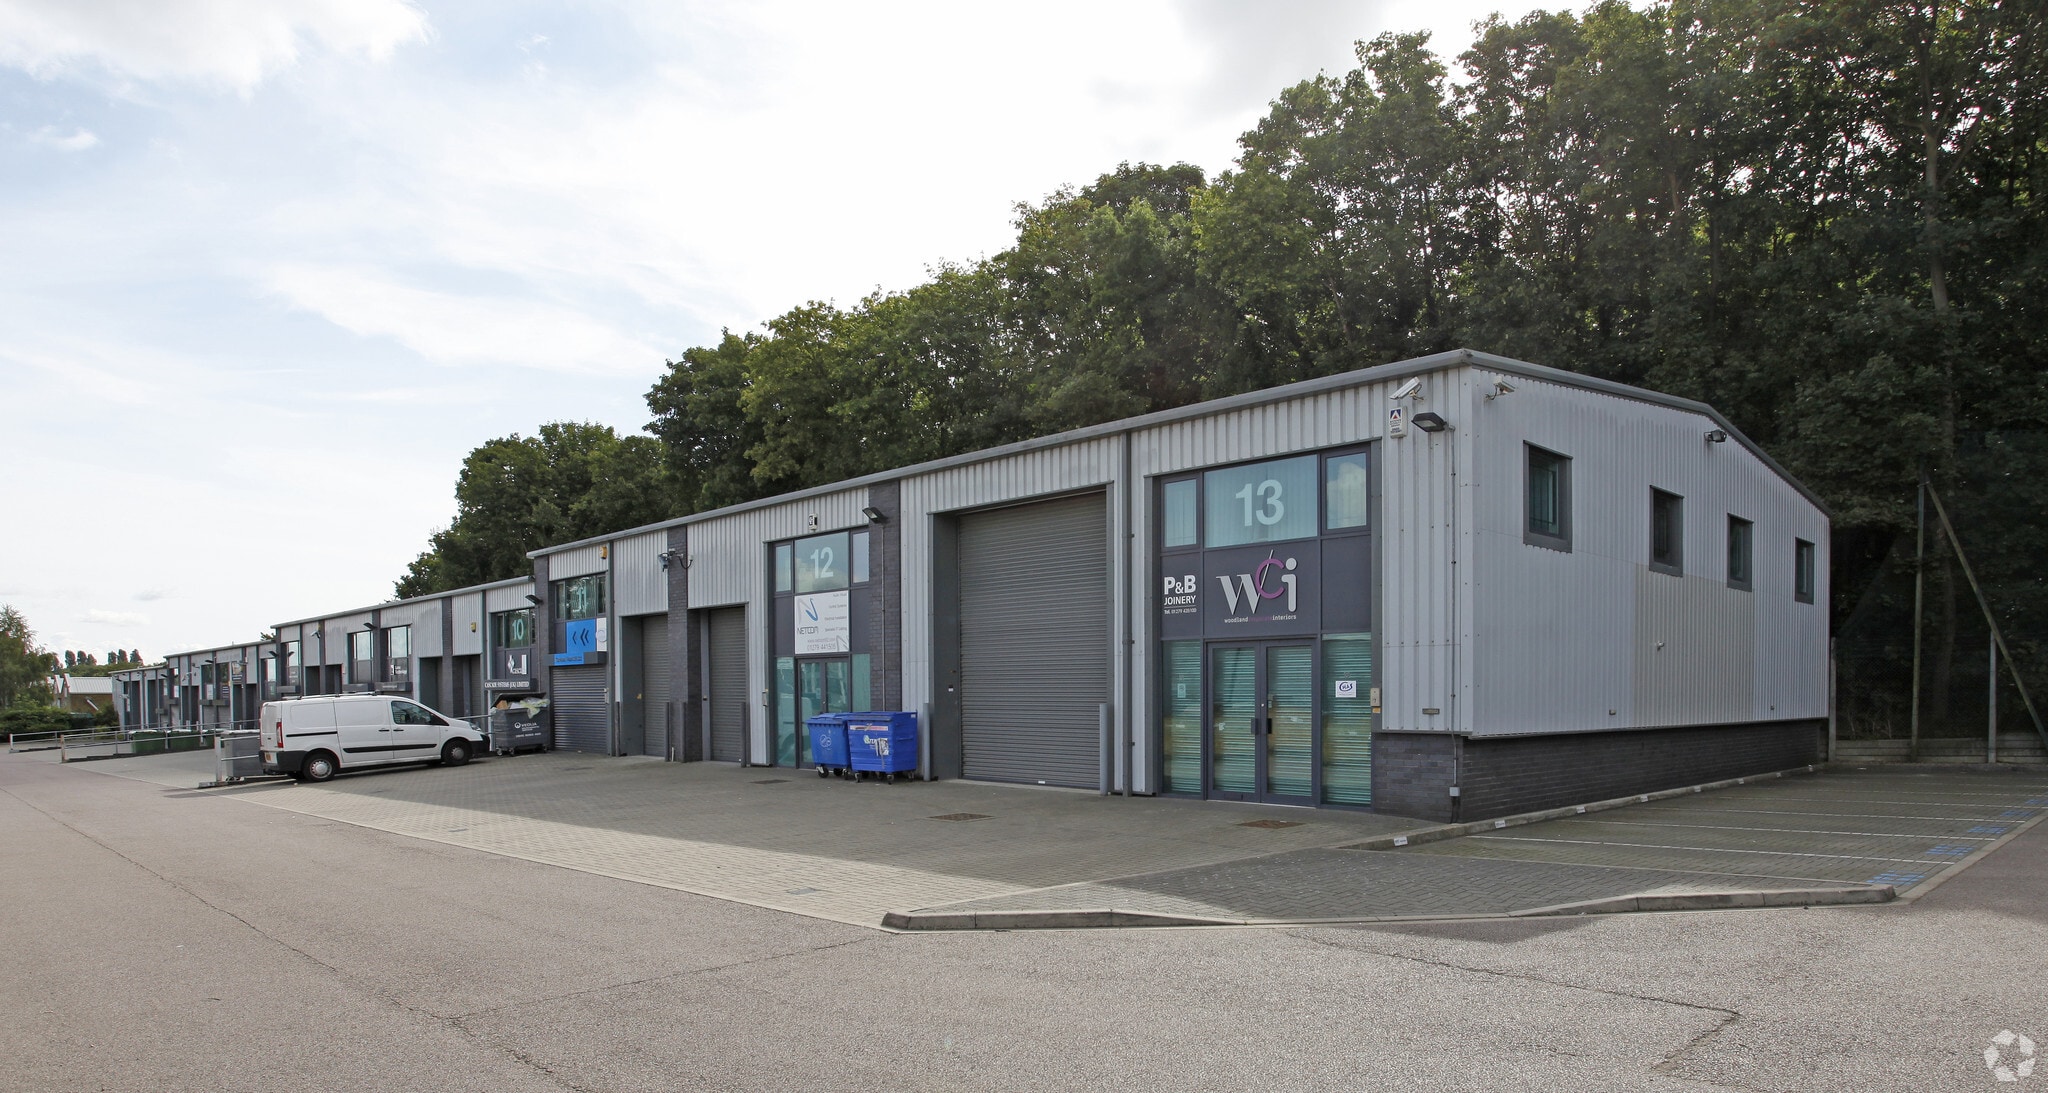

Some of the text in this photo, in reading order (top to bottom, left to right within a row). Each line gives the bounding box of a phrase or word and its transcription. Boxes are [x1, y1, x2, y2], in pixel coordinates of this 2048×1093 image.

[1235, 479, 1285, 527] 13
[810, 547, 834, 579] 12
[1163, 574, 1197, 595] P&B
[1163, 595, 1197, 606] JOINERY
[1224, 616, 1249, 624] woodland
[1272, 613, 1297, 621] interiors
[511, 618, 525, 641] 10
